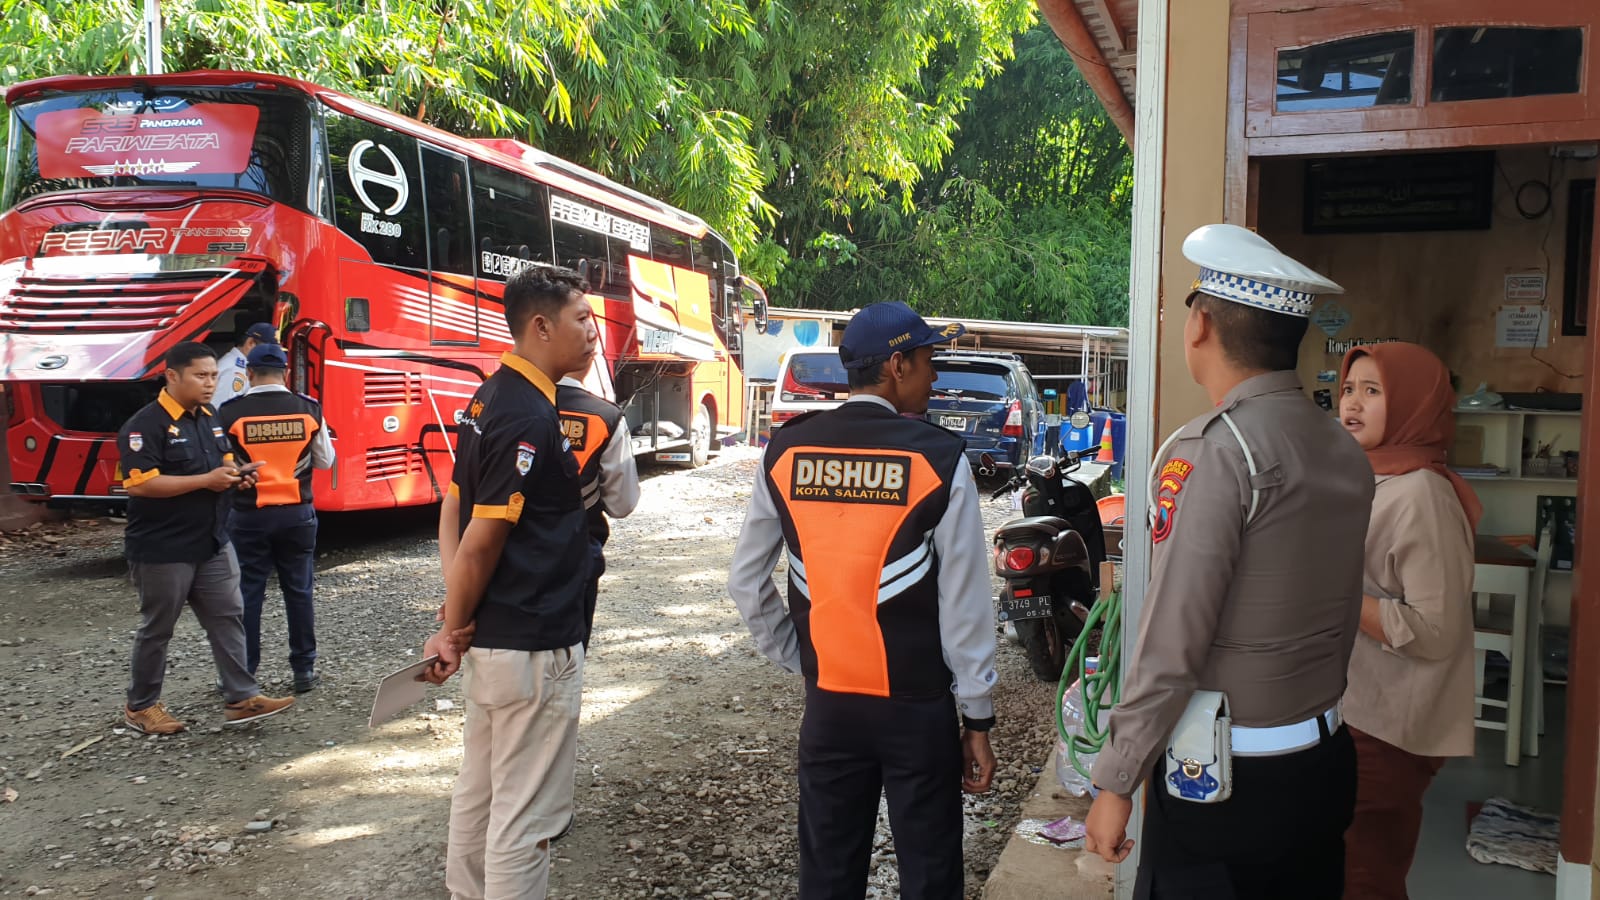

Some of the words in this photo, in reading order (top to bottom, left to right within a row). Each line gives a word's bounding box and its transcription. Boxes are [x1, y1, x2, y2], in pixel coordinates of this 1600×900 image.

[140, 118, 203, 128] PANORAMA
[64, 132, 219, 153] PARIWISATA
[40, 227, 168, 253] PESIAR
[170, 227, 252, 237] TRANSINDO
[207, 242, 248, 253] SR3
[889, 332, 911, 347] DIDIK
[246, 421, 303, 437] DISHUB
[796, 459, 904, 490] DISHUB
[795, 487, 829, 496] KOTA
[834, 488, 900, 501] SALATIGA
[1008, 599, 1030, 610] 3749
[1038, 596, 1051, 606] PL
